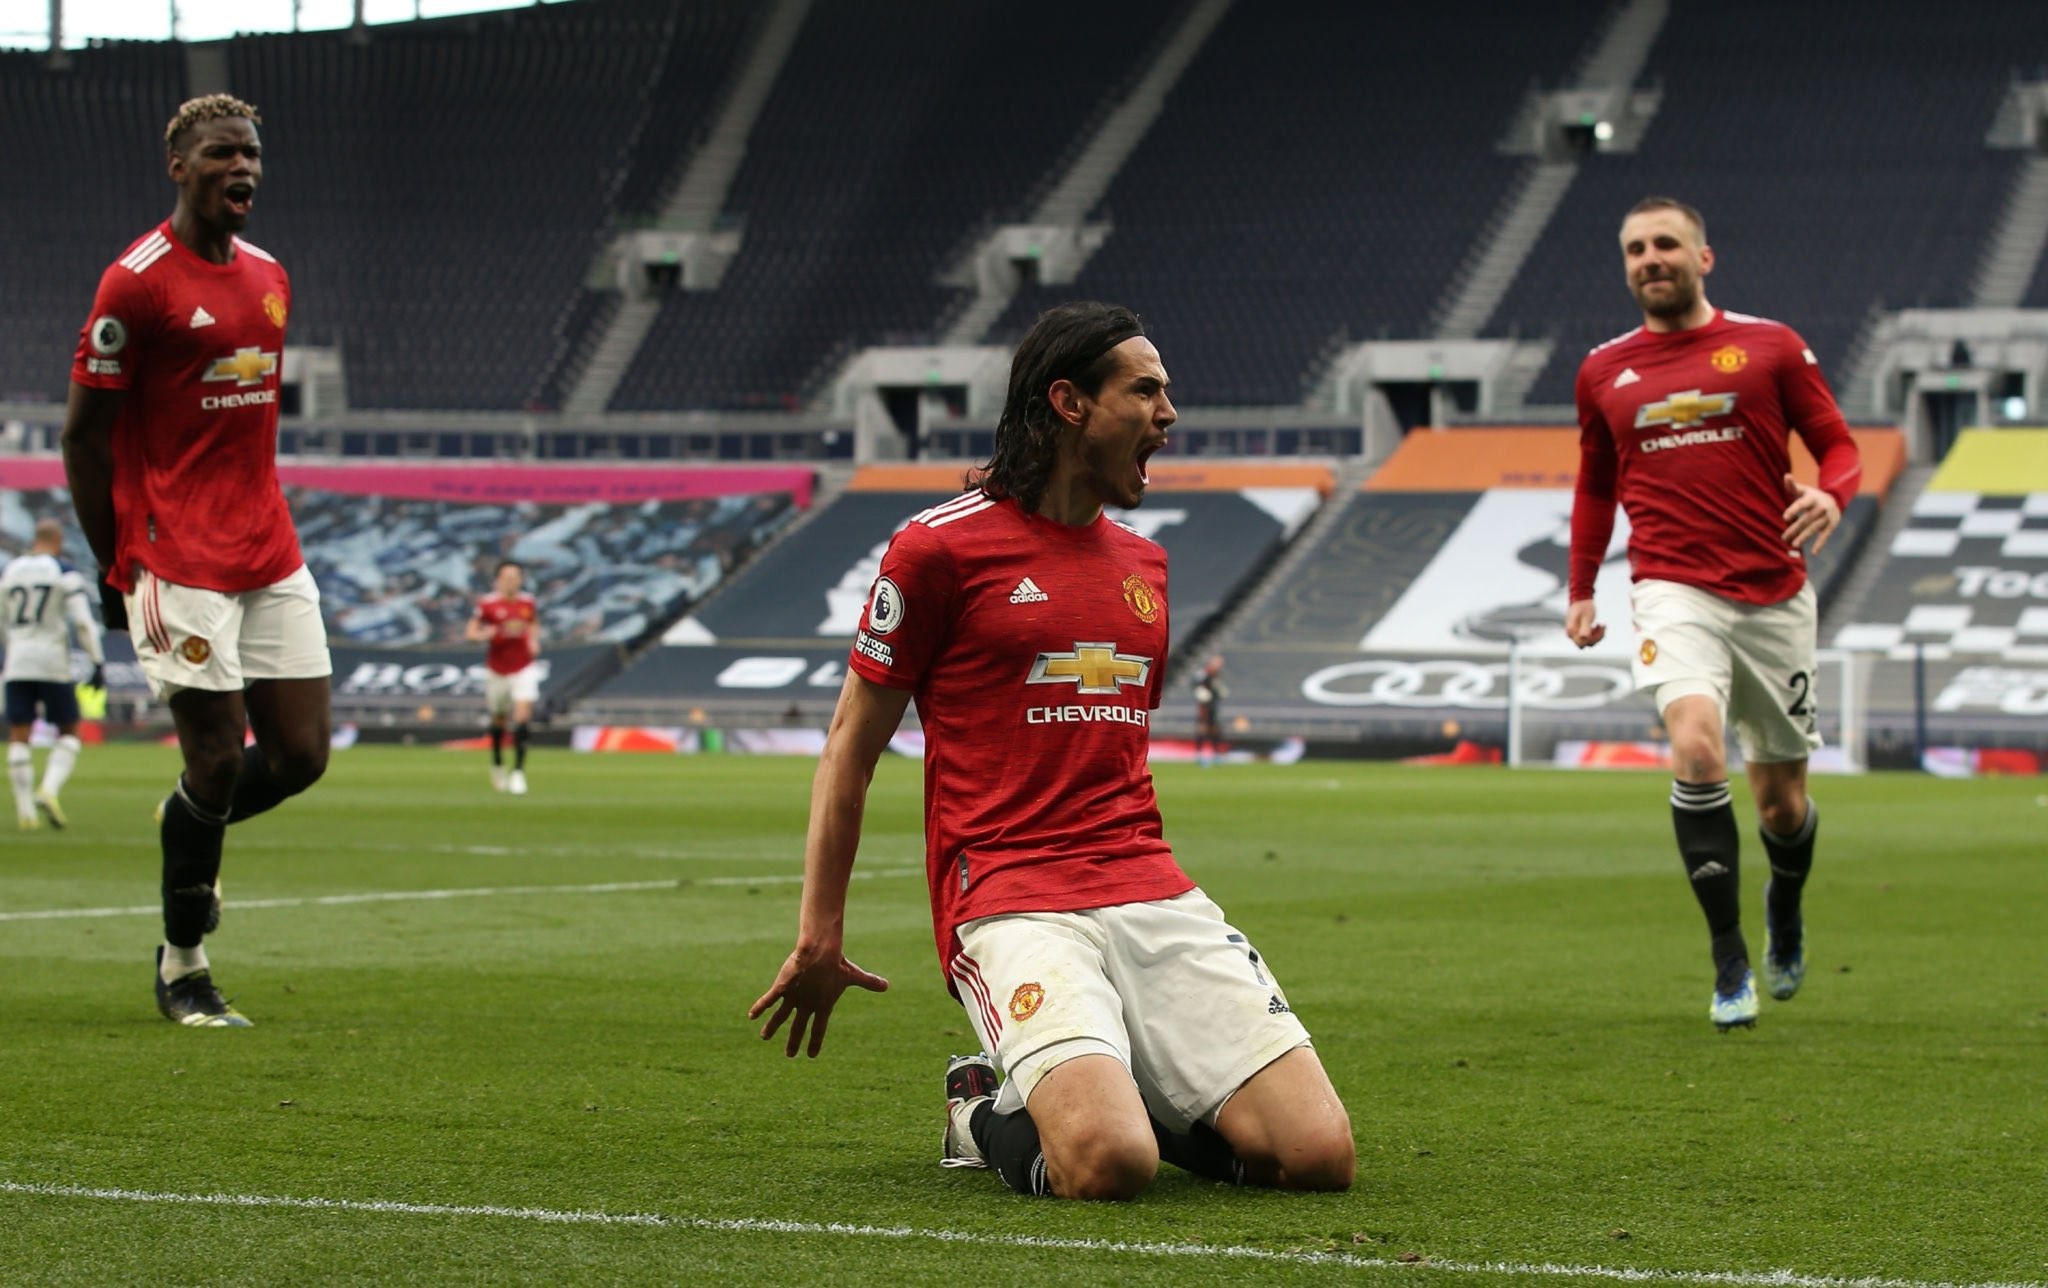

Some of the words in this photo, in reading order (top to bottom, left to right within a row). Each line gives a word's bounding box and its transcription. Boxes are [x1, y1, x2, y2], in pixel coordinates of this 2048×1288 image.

[1640, 426, 1744, 453] CHEVROLET
[9, 585, 54, 624] 27
[1009, 592, 1049, 604] adidas
[858, 629, 868, 643] No
[867, 635, 892, 655] room
[863, 646, 893, 667] racism
[1788, 670, 1816, 716] 2
[1027, 705, 1148, 727] CHEVROLET
